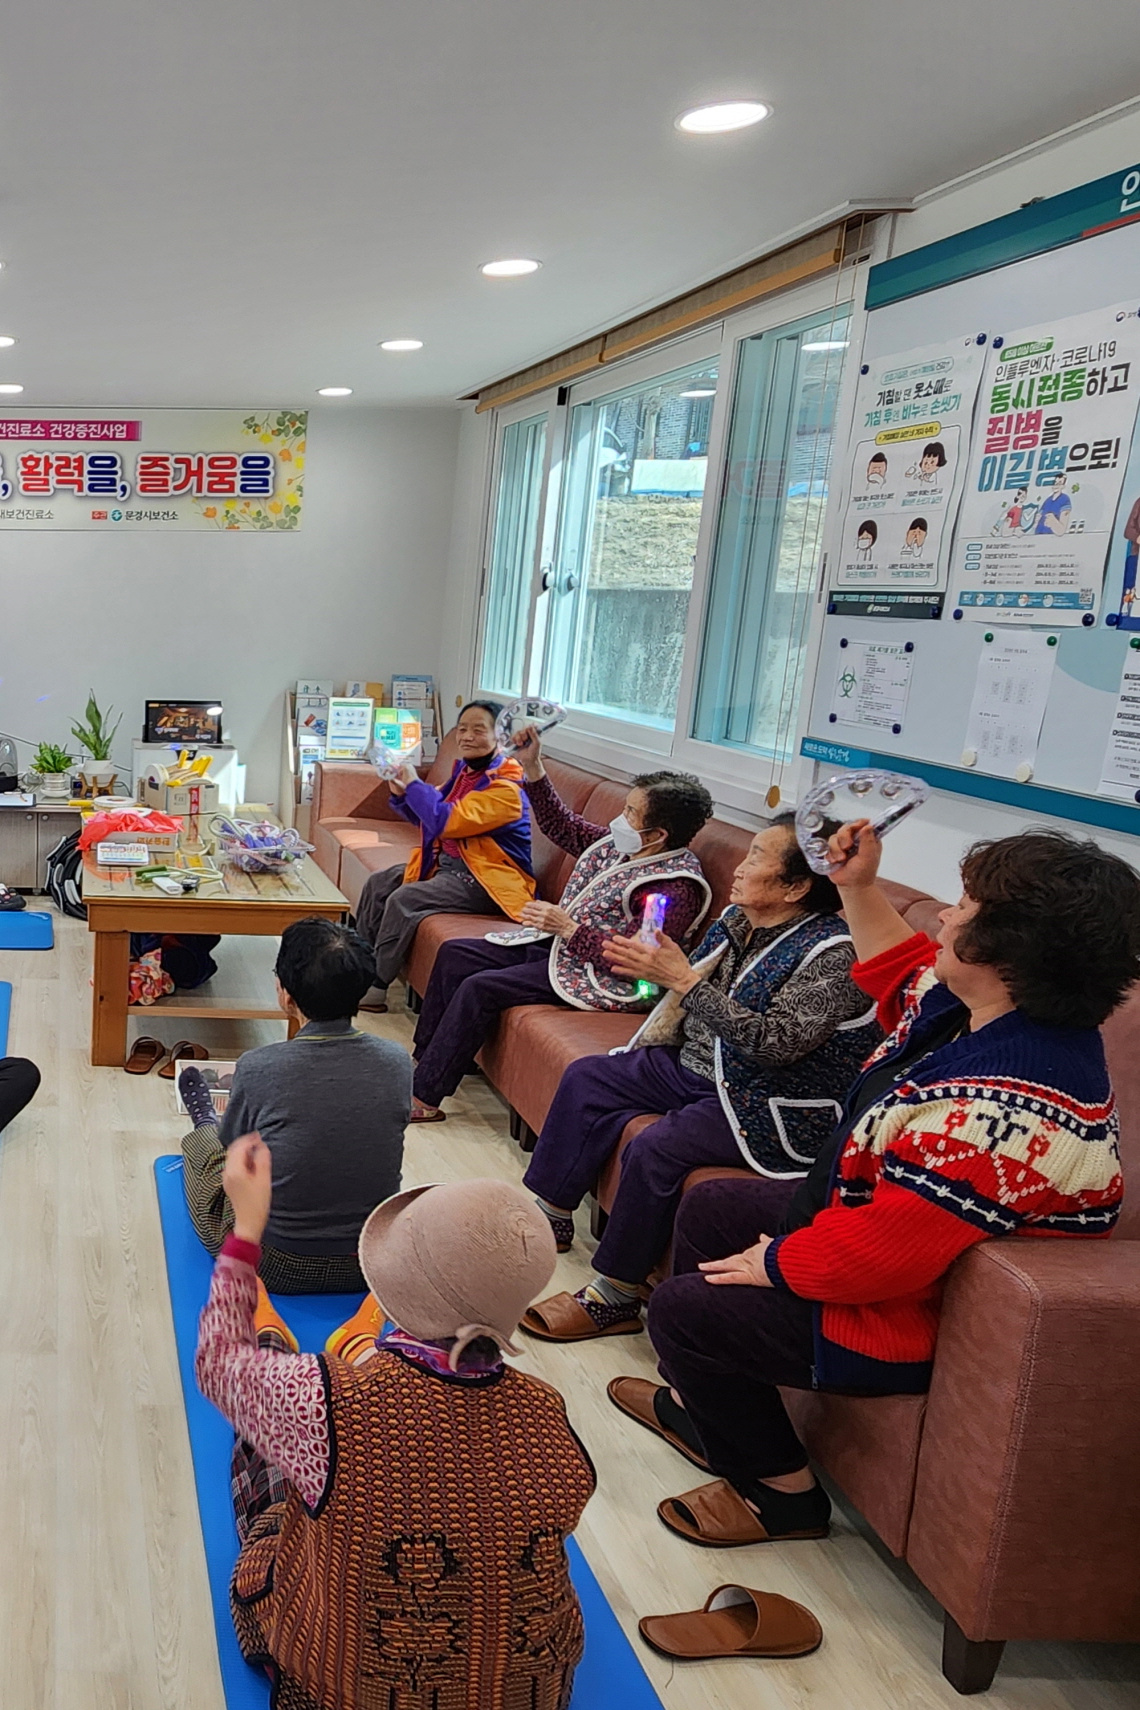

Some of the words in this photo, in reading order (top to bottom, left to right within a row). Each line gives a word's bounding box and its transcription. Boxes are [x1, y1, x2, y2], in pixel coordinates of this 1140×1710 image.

[913, 377, 953, 400] 옷소매로
[990, 362, 1131, 414] 동시접종하고
[864, 410, 881, 427] 기침
[901, 403, 928, 420] 비누로
[930, 393, 962, 415] 손씻기
[49, 423, 127, 439] 건강증진사업
[984, 409, 1063, 454] 질병을
[19, 453, 128, 498] 활력을,
[138, 454, 272, 495] 즐거움을
[125, 510, 179, 521] 문경시보건소
